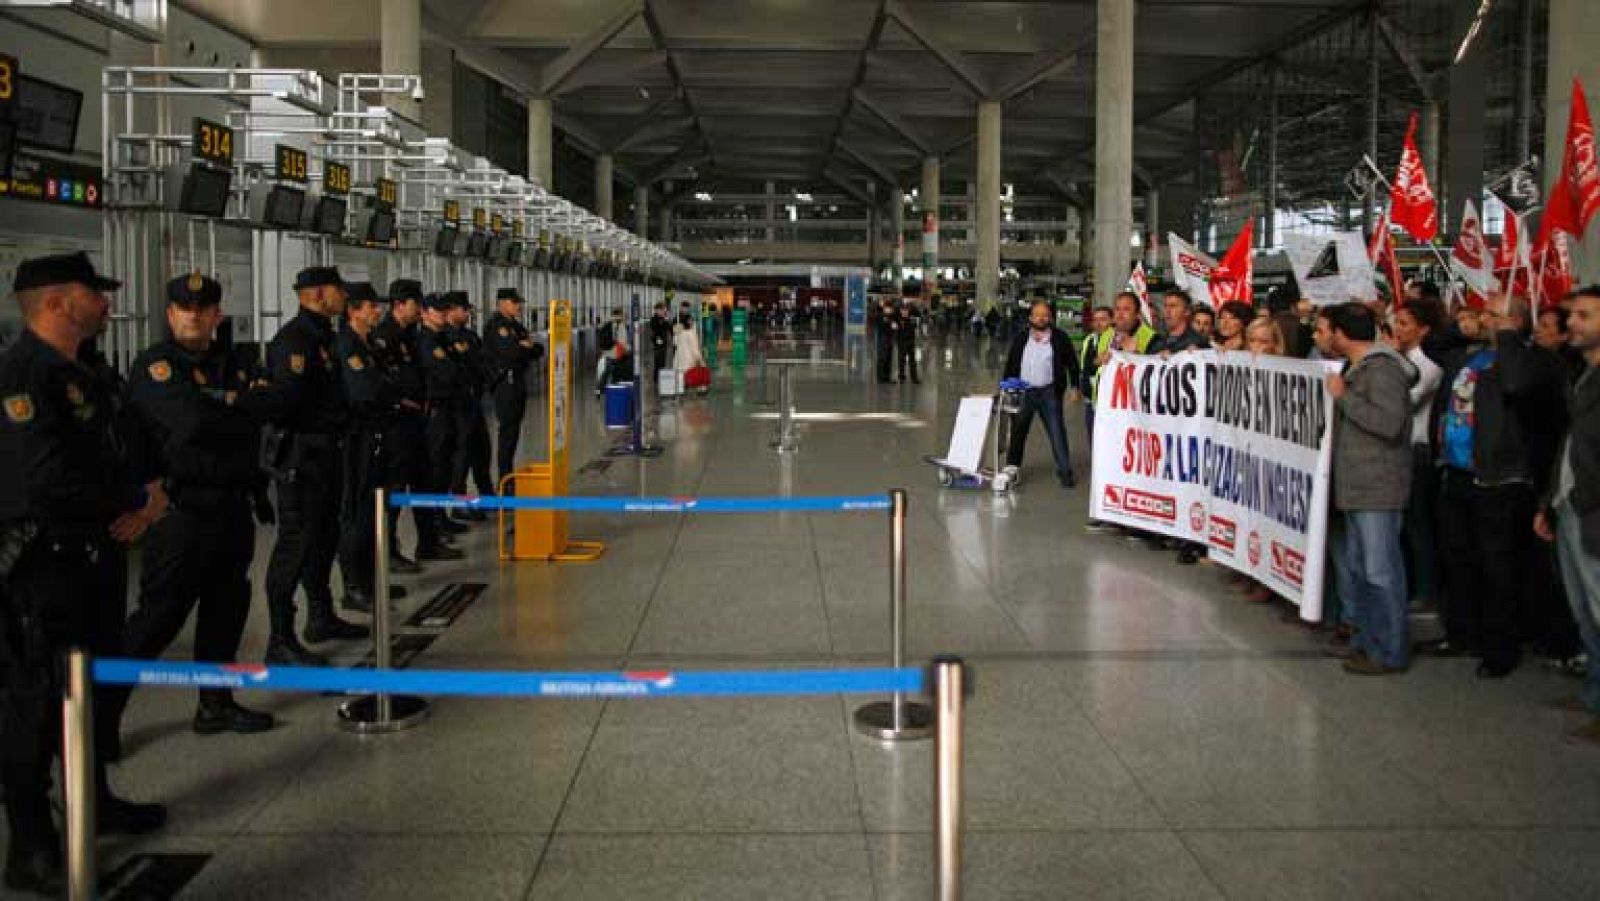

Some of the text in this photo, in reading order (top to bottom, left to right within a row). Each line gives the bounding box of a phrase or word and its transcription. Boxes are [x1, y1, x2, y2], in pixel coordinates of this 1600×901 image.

[201, 124, 231, 160] 314
[281, 149, 305, 178] 315
[1139, 364, 1155, 415] A
[1156, 362, 1198, 418] LOS
[1122, 426, 1162, 478] STOP
[1162, 432, 1174, 482] A
[1176, 433, 1200, 485] LA
